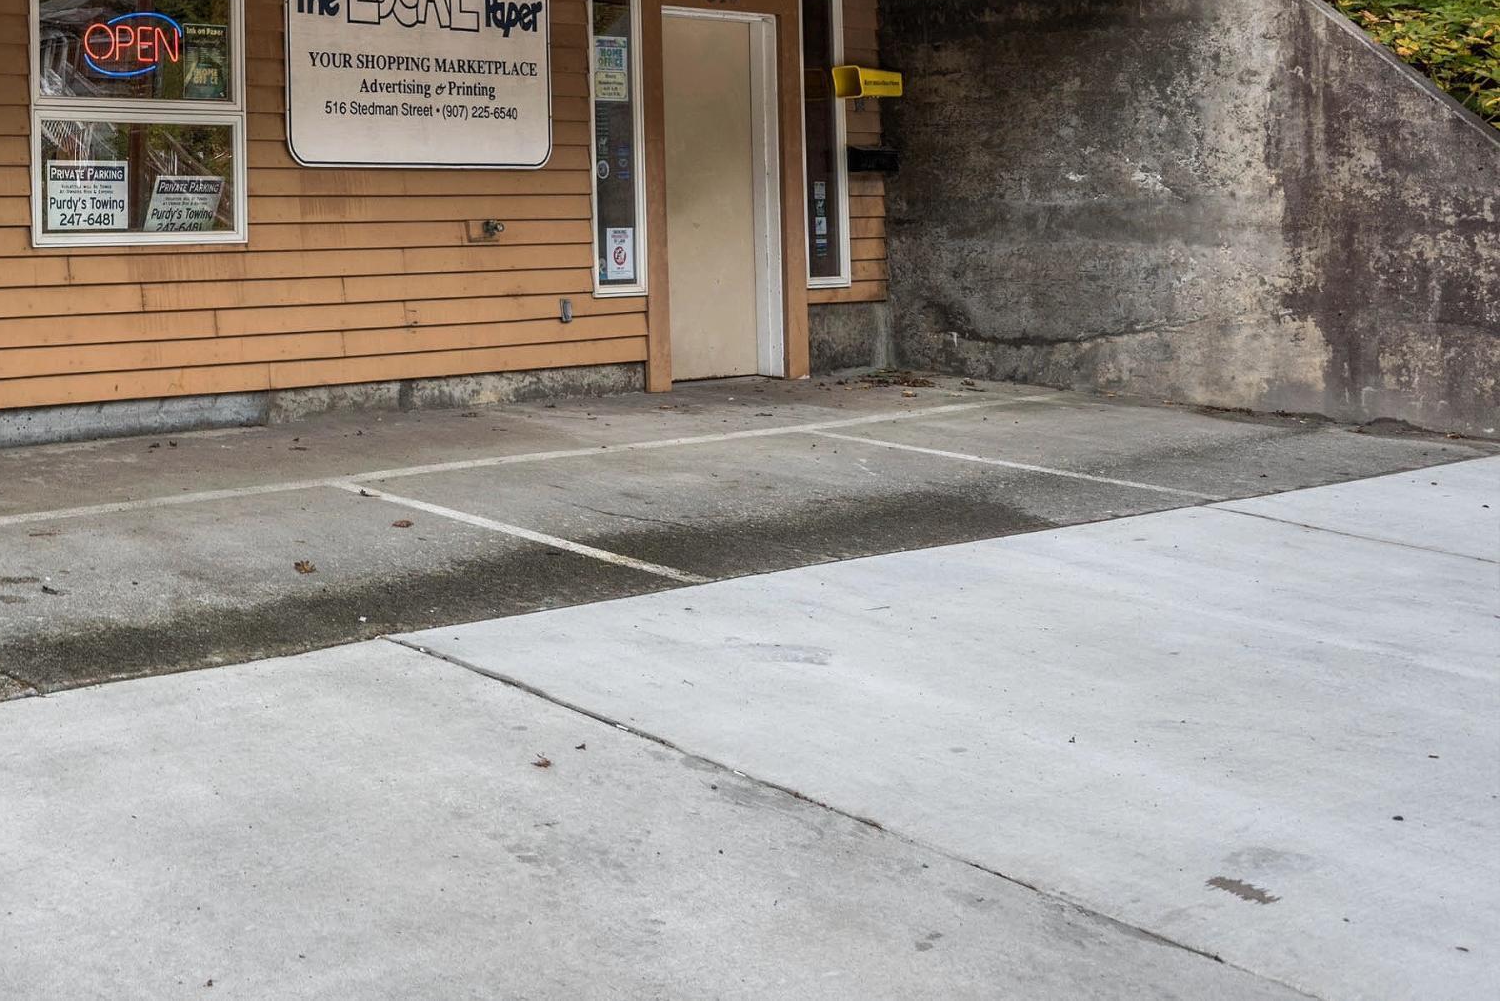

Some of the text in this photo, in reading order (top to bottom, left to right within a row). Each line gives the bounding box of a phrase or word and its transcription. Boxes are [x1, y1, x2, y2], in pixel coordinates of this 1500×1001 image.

[84, 23, 179, 62] OPEN
[308, 51, 538, 77] YOUR SHOPPING MARKETPLACE
[359, 78, 496, 100] Advertising & Printing
[325, 100, 518, 121] 516 Stedman Street (907) 225-6540
[50, 167, 123, 179] PRIVATE PARKING
[160, 181, 220, 193] PRIVATE PARKING
[50, 196, 125, 212] Purdy's Towing
[60, 213, 115, 226] 247-6481
[151, 207, 214, 222] Purdy's Towing
[155, 222, 202, 232] 247-6481
